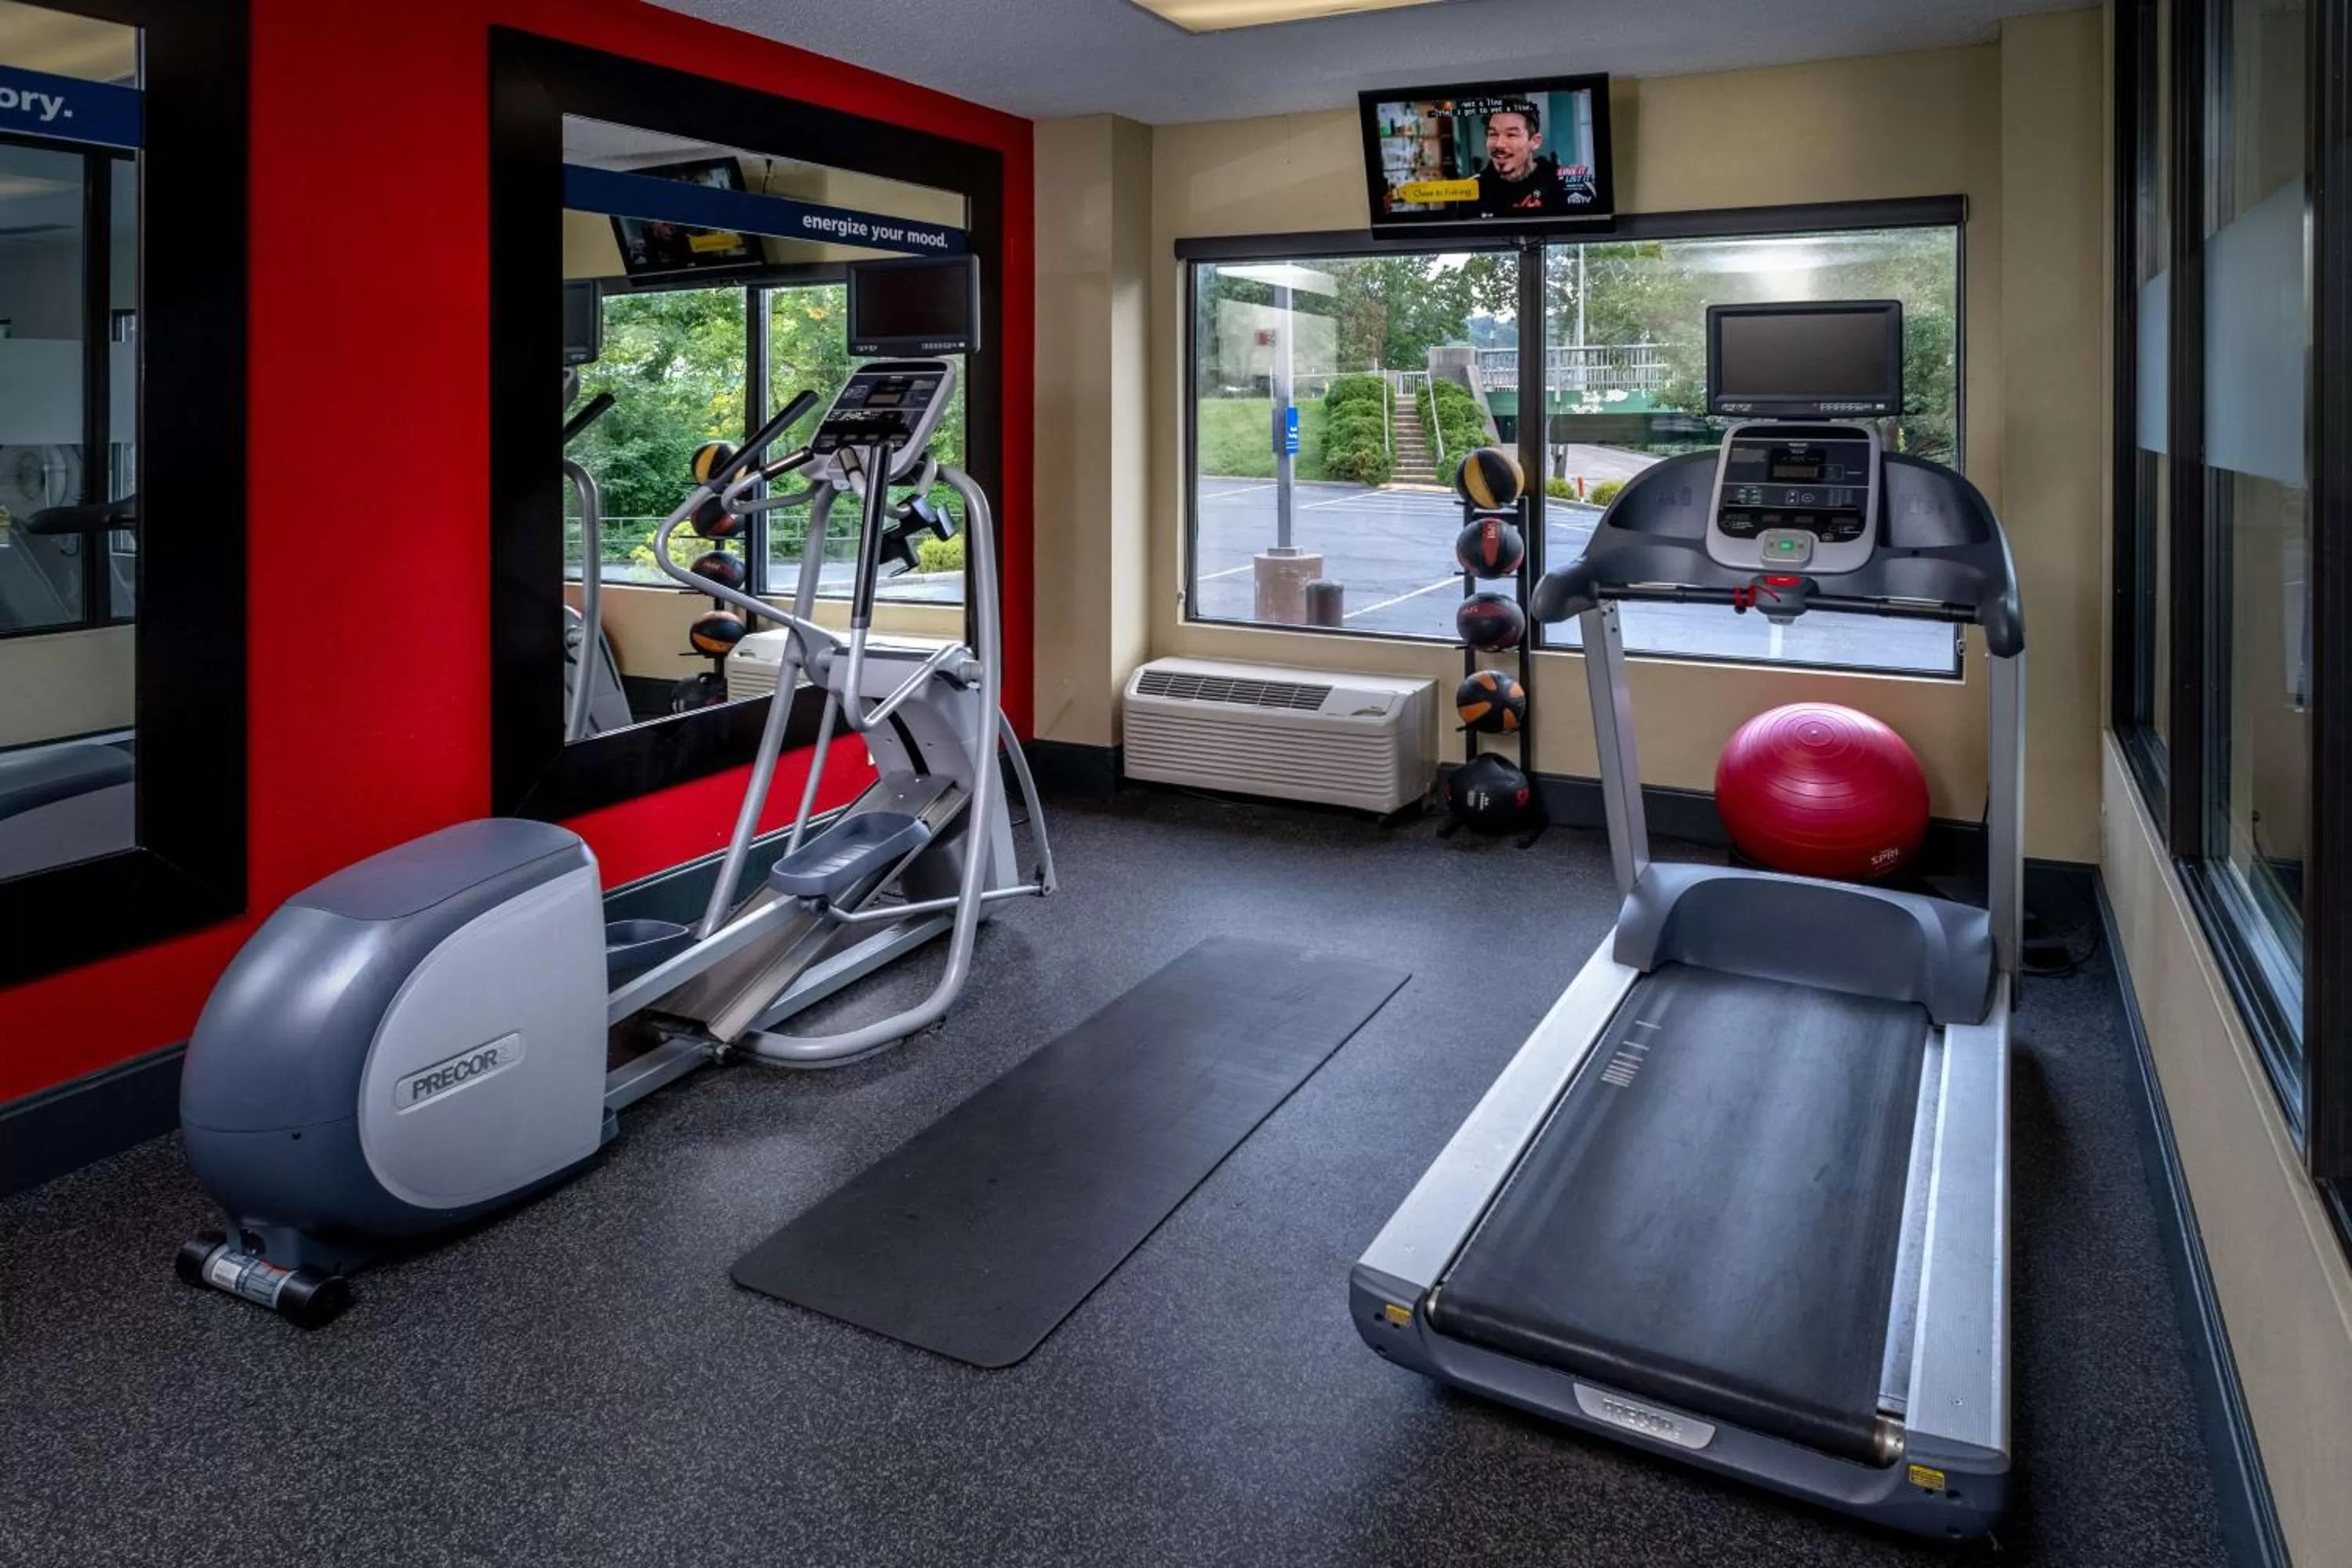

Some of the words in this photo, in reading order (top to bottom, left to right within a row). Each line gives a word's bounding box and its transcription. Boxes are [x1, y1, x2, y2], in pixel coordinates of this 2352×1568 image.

[802, 214, 868, 237] energize
[872, 225, 903, 241] your
[907, 230, 948, 249] mood.
[412, 1049, 498, 1100] PRECOR
